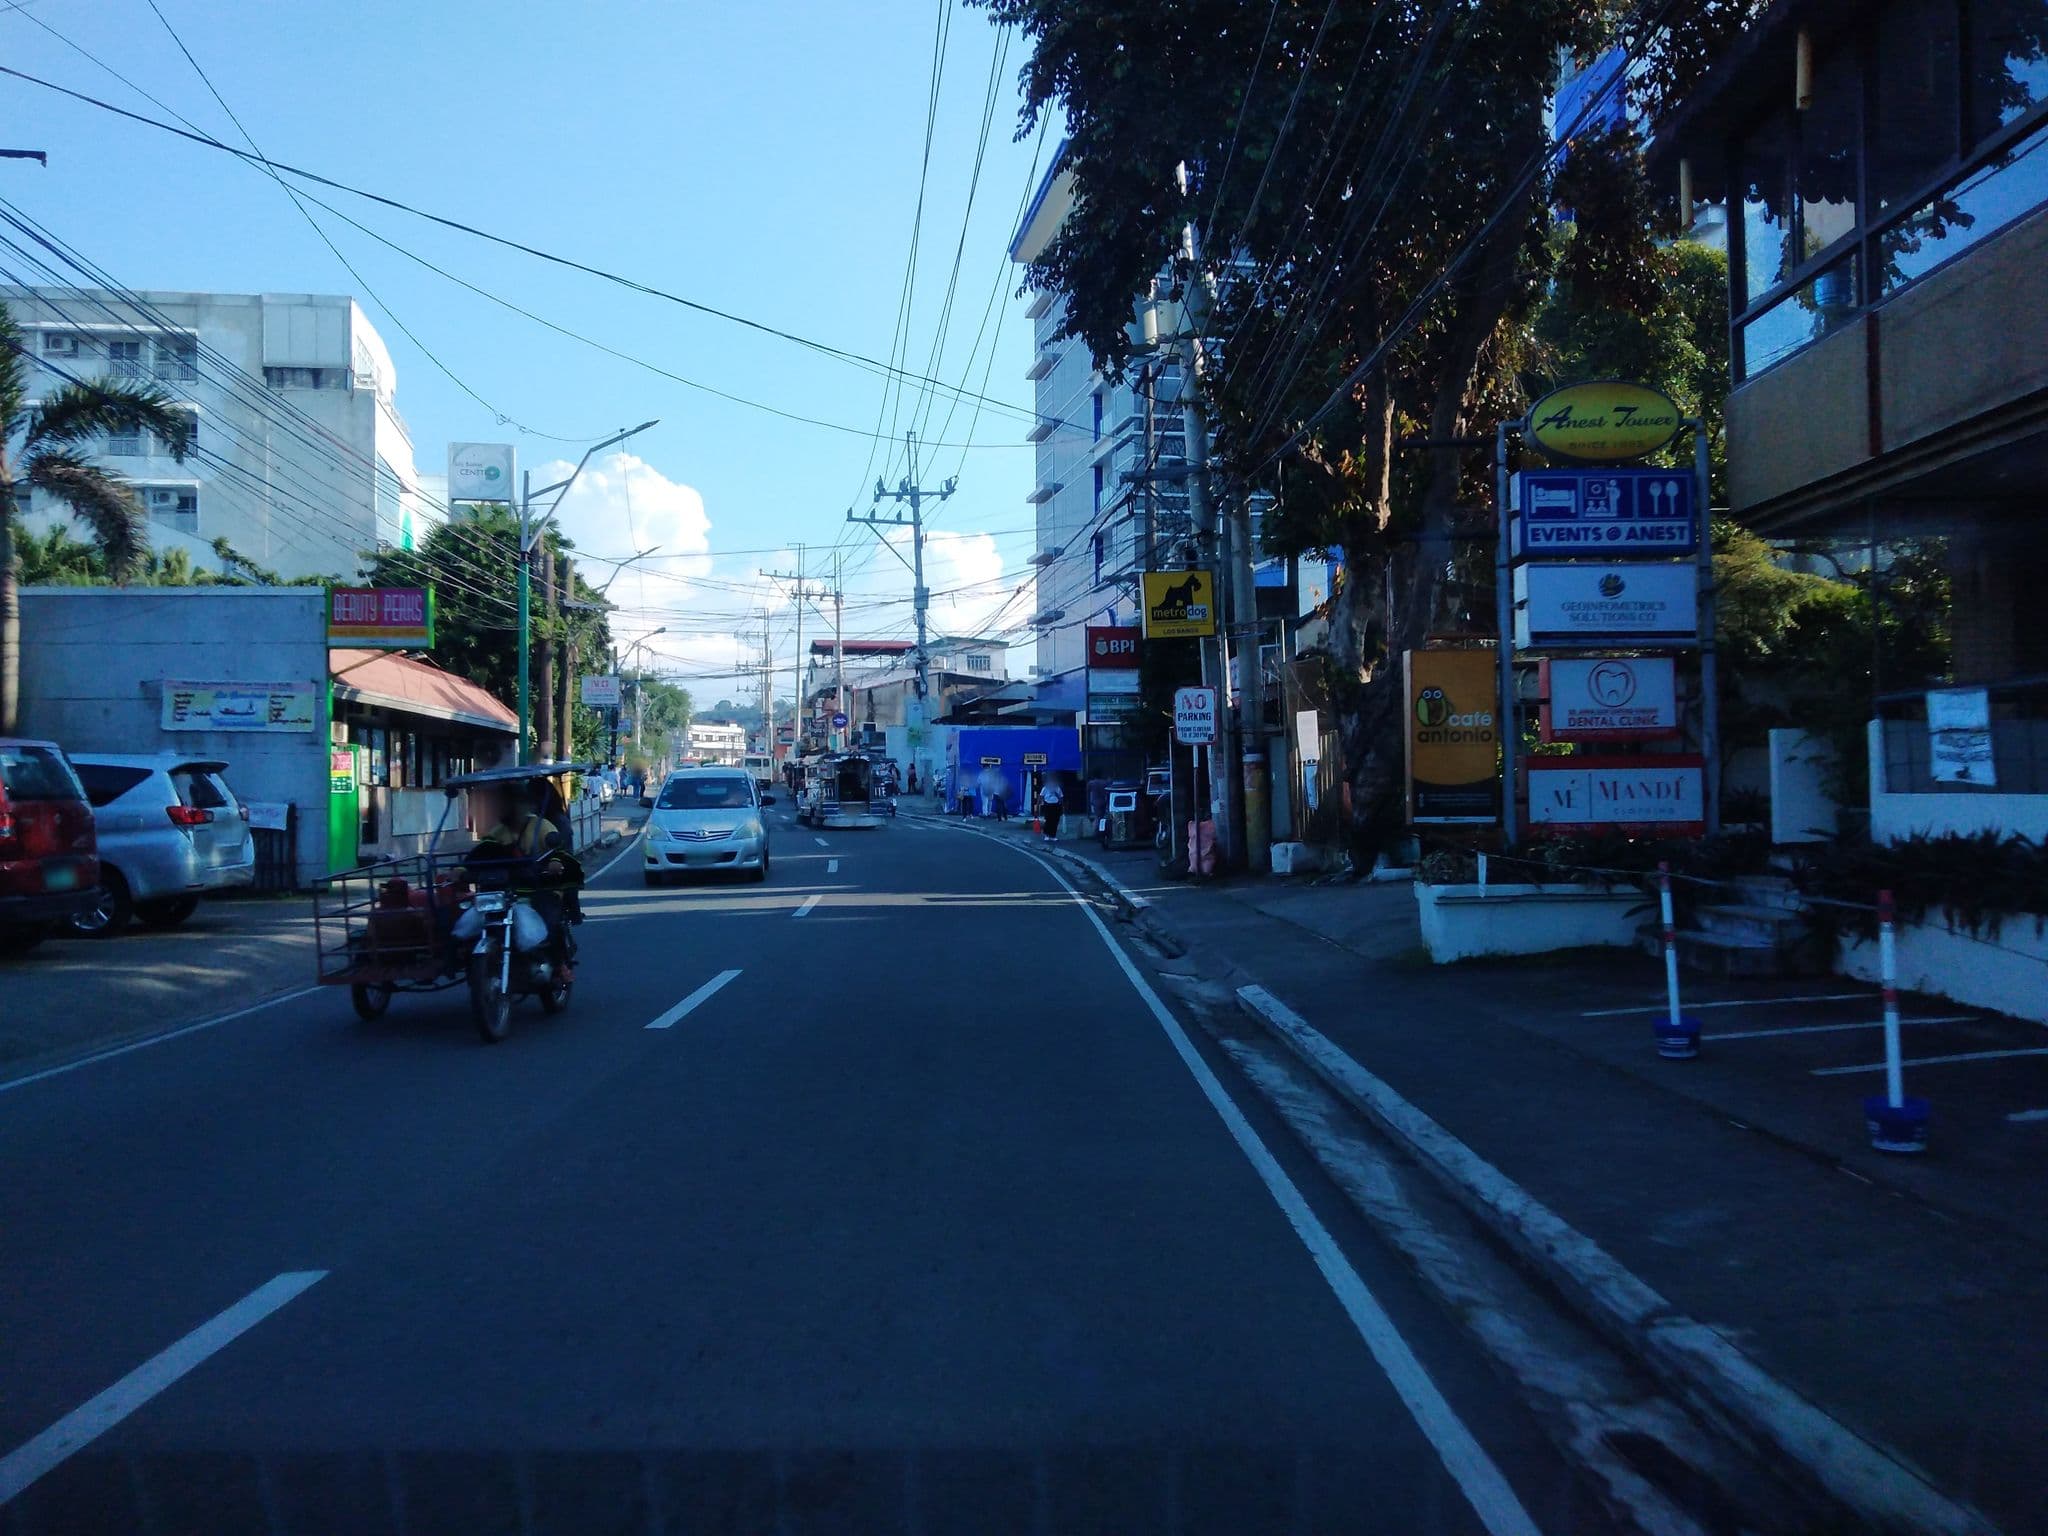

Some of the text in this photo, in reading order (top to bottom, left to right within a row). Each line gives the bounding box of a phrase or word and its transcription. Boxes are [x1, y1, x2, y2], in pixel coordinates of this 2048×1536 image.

[1536, 404, 1673, 431] Anest Tower
[1530, 525, 1687, 542] EVENTS @ ANEST
[333, 593, 377, 622] BEAUTY
[1110, 639, 1135, 654] BPI
[1182, 694, 1207, 710] NO
[1178, 712, 1211, 721] PARKING
[1448, 711, 1493, 726] café
[1568, 714, 1659, 727] DENTAL CLINIC
[1417, 728, 1492, 743] antonio
